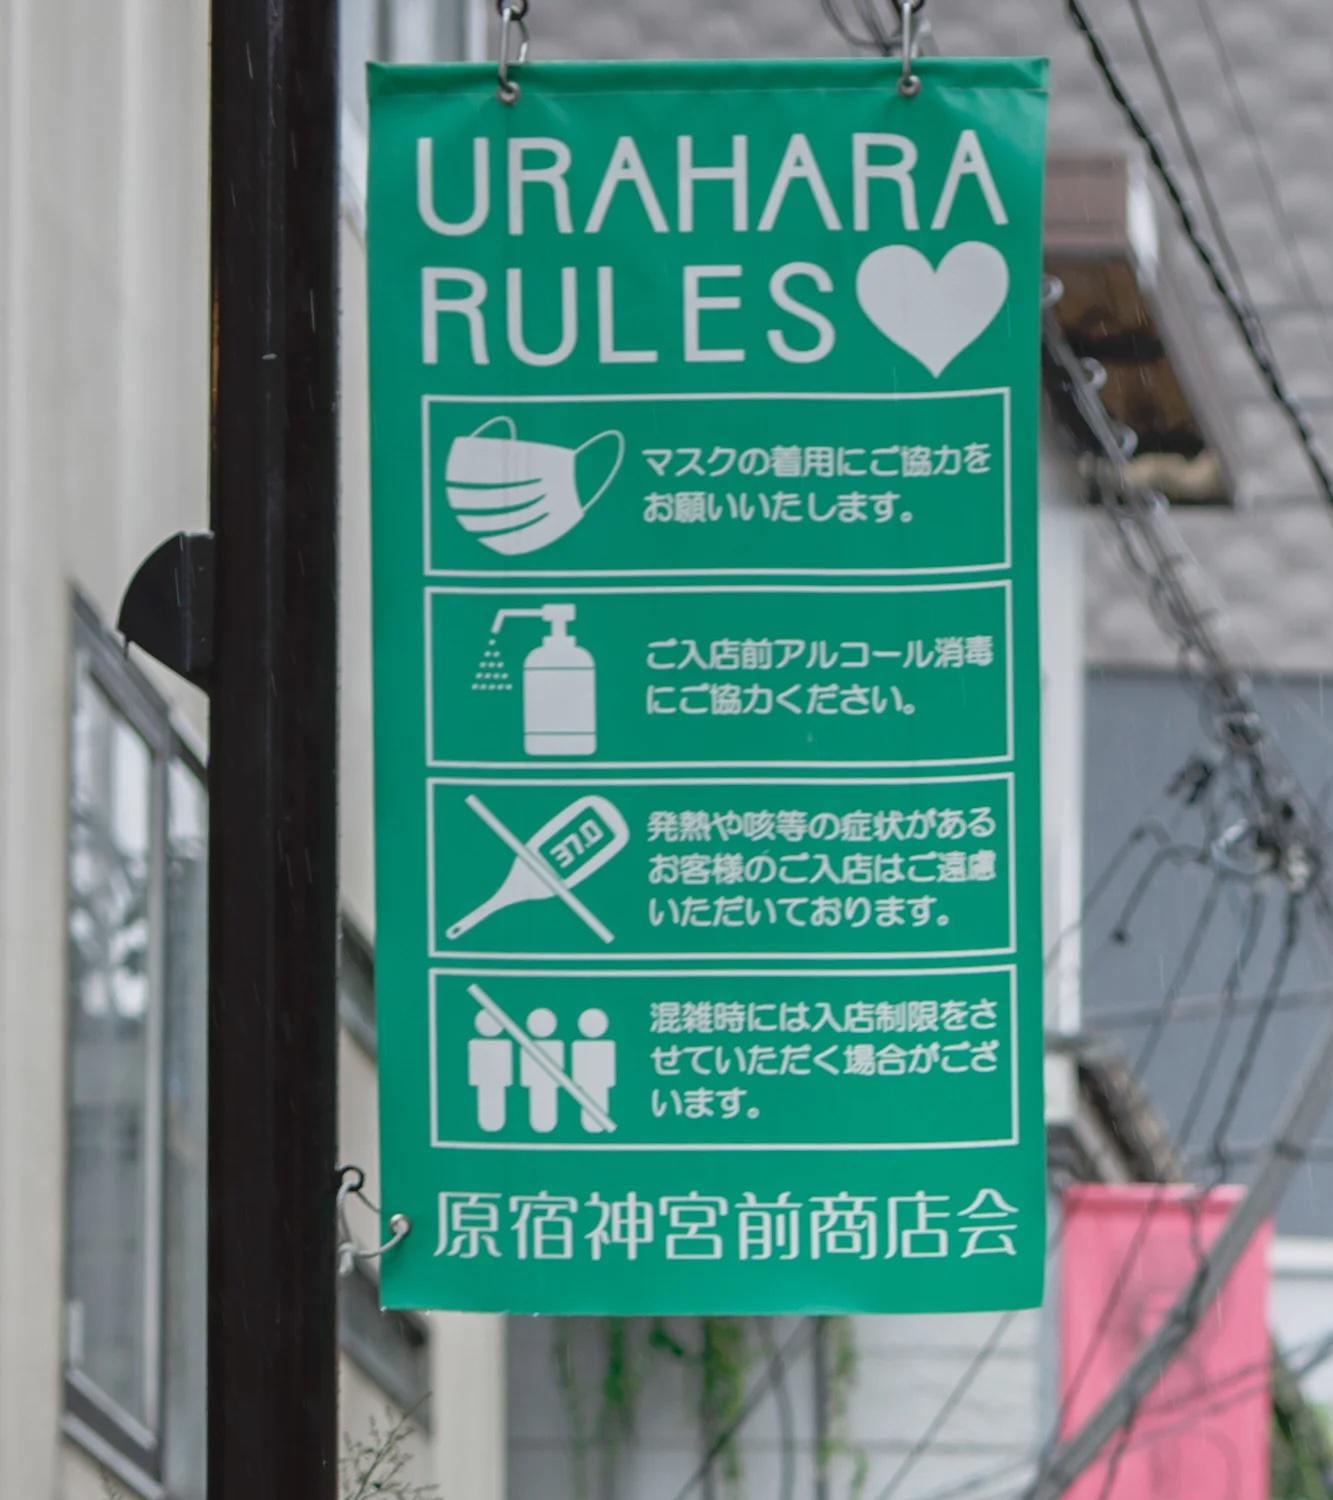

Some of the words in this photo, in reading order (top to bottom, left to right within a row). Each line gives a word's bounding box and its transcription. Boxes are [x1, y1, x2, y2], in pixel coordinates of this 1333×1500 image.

[416, 129, 1009, 237] URAHARA
[421, 261, 837, 367] RULES
[641, 442, 993, 479] マスクの着用にご協力を
[643, 491, 914, 524] お願いいたします。
[646, 635, 994, 671] ご入店前アルコール消毒
[646, 683, 916, 716] にご協力ください。
[647, 806, 996, 843] 発熱や咳等の症状がある
[549, 819, 605, 869] 37.0
[648, 851, 997, 885] お客様のご入店はご遠慮
[649, 896, 951, 928] いただいております。
[650, 999, 999, 1034] 混雑時には入店制限をさ
[650, 1041, 1000, 1076] せていただく場合がござ
[651, 1086, 761, 1120] います。
[433, 1188, 1020, 1261] 原宿神宮前商店会
